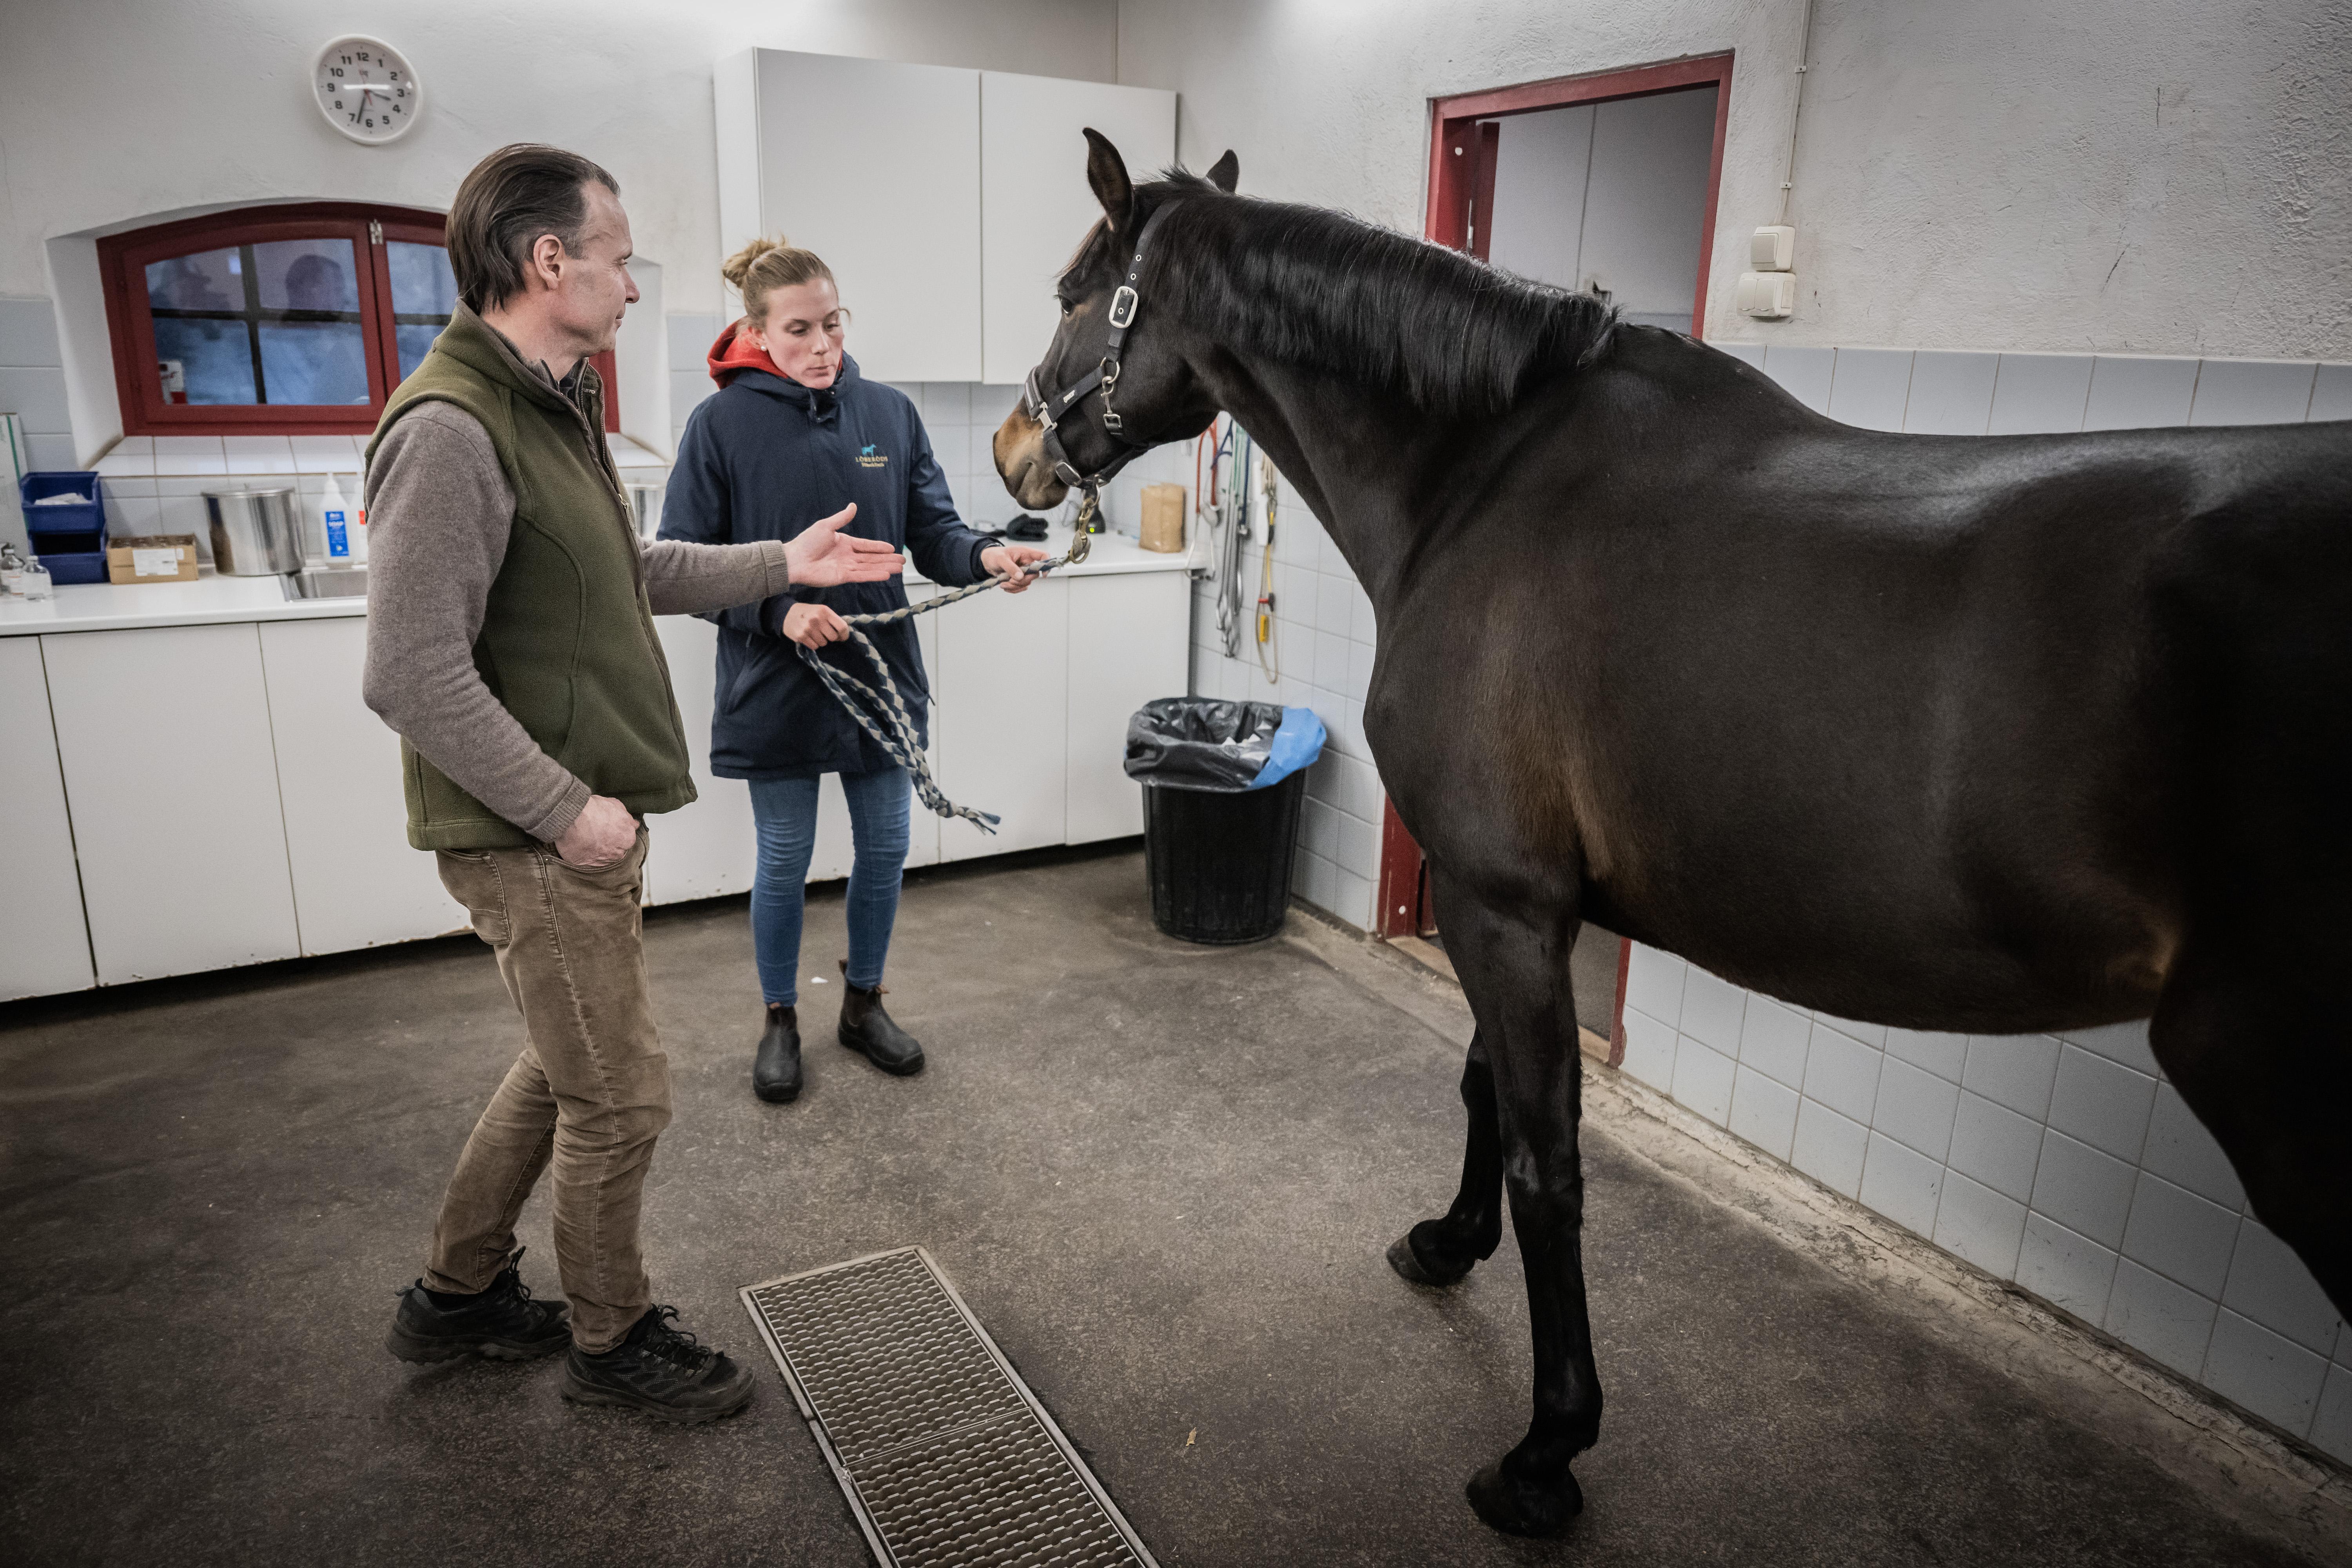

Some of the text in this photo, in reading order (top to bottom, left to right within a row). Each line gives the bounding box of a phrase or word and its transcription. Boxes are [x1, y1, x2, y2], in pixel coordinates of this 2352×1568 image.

[341, 55, 352, 65] 11
[356, 52, 369, 62] 12
[377, 58, 383, 67] 1
[330, 67, 344, 77] 10
[390, 71, 398, 81] 2
[327, 83, 335, 93] 9
[397, 88, 405, 98] 3
[335, 100, 343, 109] 8
[392, 104, 401, 113] 4
[348, 113, 356, 122] 7
[382, 115, 390, 125] 5
[365, 118, 373, 128] 6
